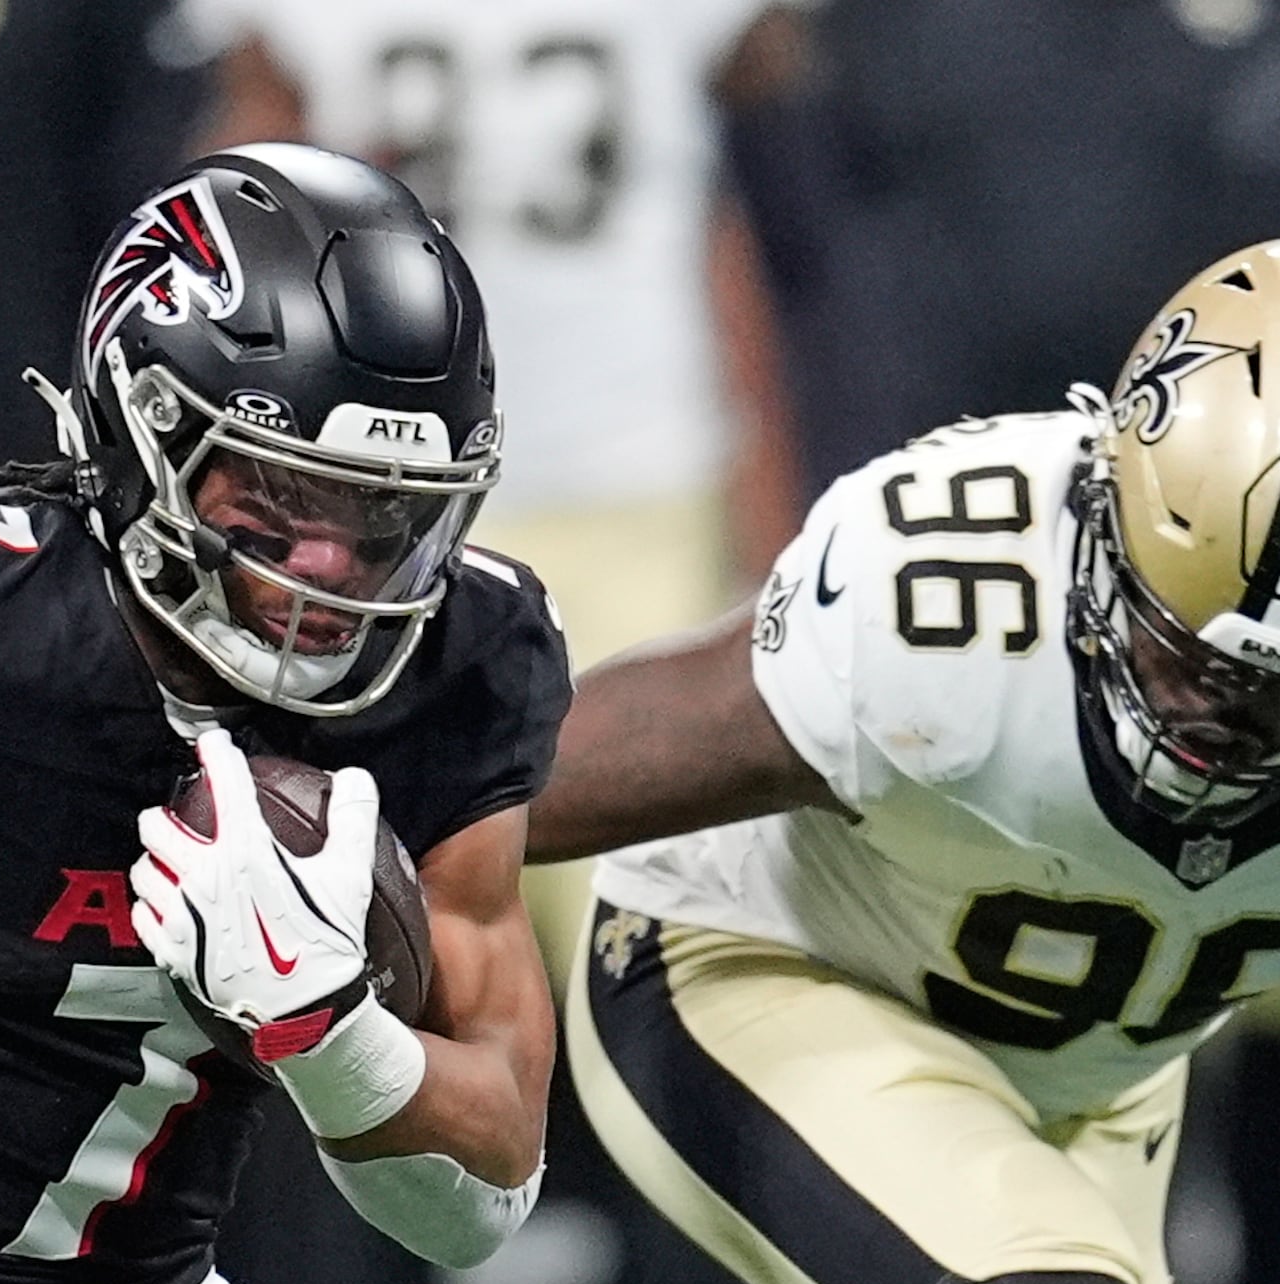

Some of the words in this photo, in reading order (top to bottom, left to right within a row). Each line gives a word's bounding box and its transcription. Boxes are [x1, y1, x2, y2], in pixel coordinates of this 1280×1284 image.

[365, 418, 427, 443] ATL
[881, 464, 1040, 654] 96
[0, 963, 216, 1260] 7
